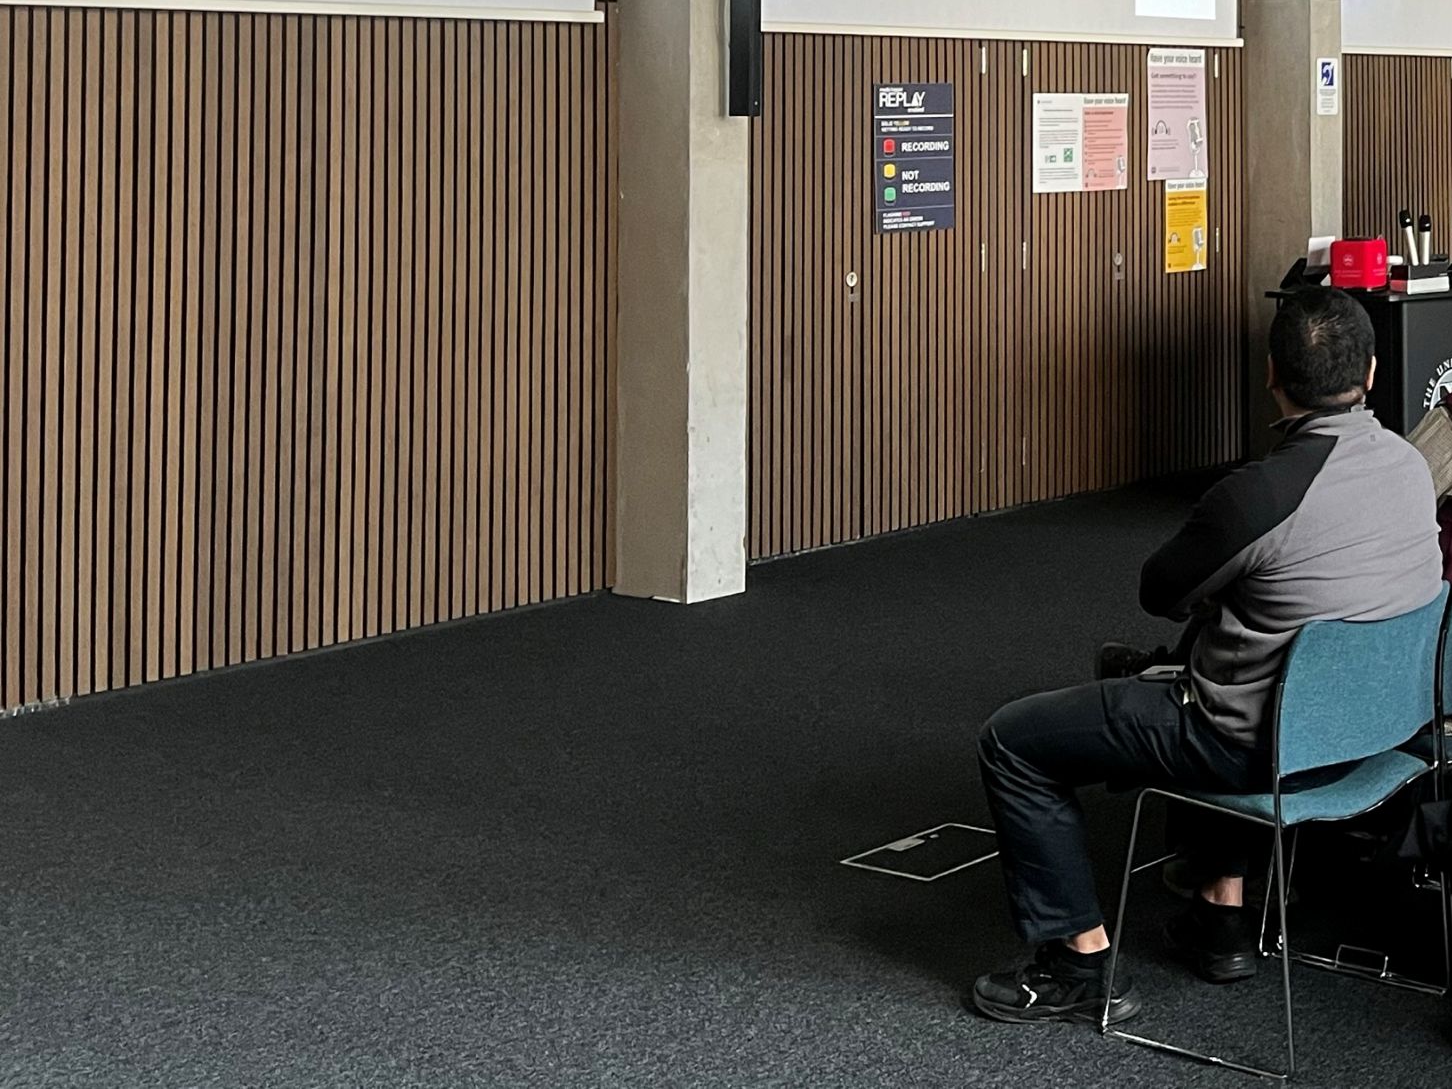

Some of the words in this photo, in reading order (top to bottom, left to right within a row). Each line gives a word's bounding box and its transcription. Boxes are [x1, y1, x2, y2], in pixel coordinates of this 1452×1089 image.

[878, 91, 926, 108] REPLAY
[901, 140, 950, 152] RECORDING
[901, 170, 919, 181] NOT
[901, 181, 951, 193] RECORDING
[1423, 377, 1436, 408] THE
